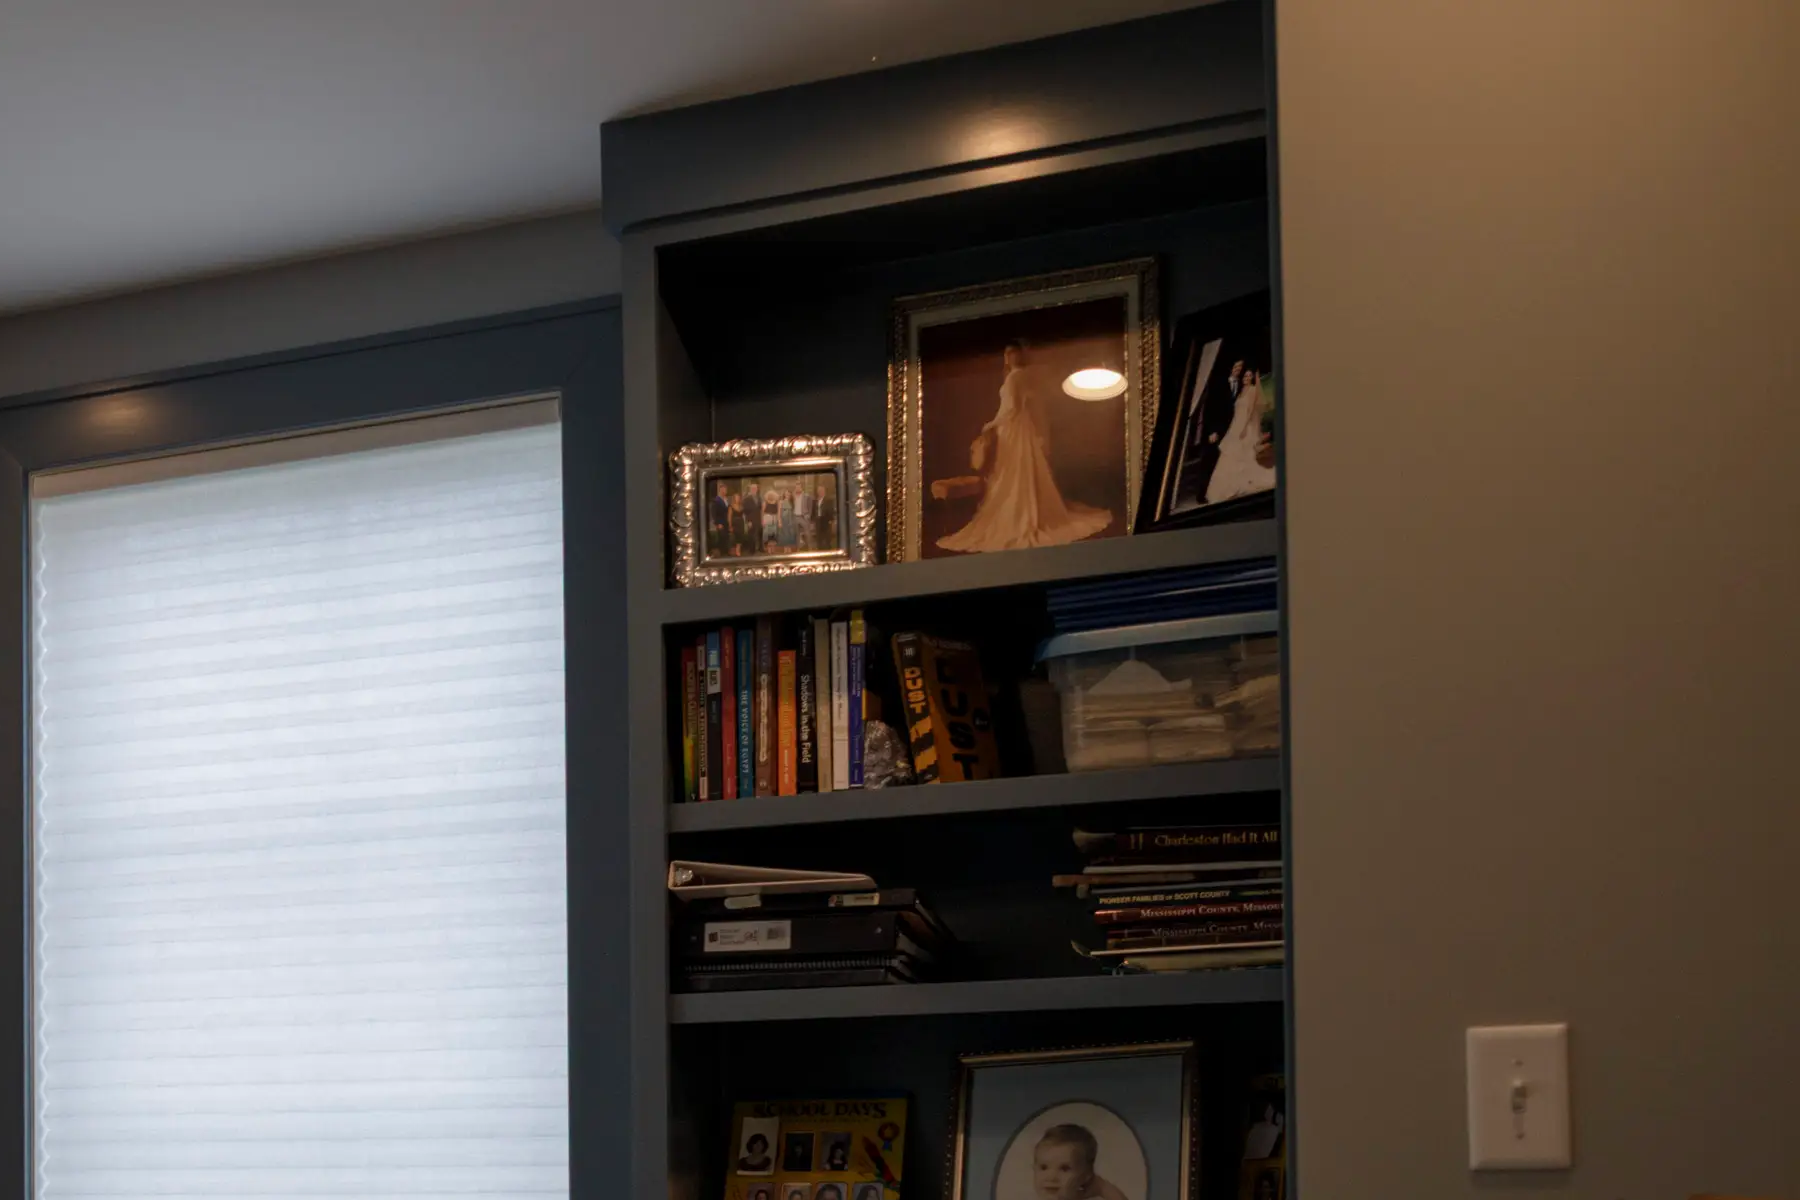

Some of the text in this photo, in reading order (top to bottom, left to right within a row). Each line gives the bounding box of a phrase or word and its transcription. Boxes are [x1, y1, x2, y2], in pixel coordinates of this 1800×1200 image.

[741, 690, 749, 707] THE
[800, 674, 811, 714] Shadows
[903, 666, 927, 715] DUST
[741, 735, 749, 746] OF
[802, 725, 812, 742] the
[741, 748, 750, 774] EGYPT
[802, 743, 813, 764] Field
[1154, 832, 1219, 848] Charleston
[1222, 831, 1246, 846] Had
[1174, 892, 1200, 901] SCOTT
[1139, 907, 1197, 919] MISSISSIPPI
[753, 1101, 888, 1118] SCHOOL DAYS
